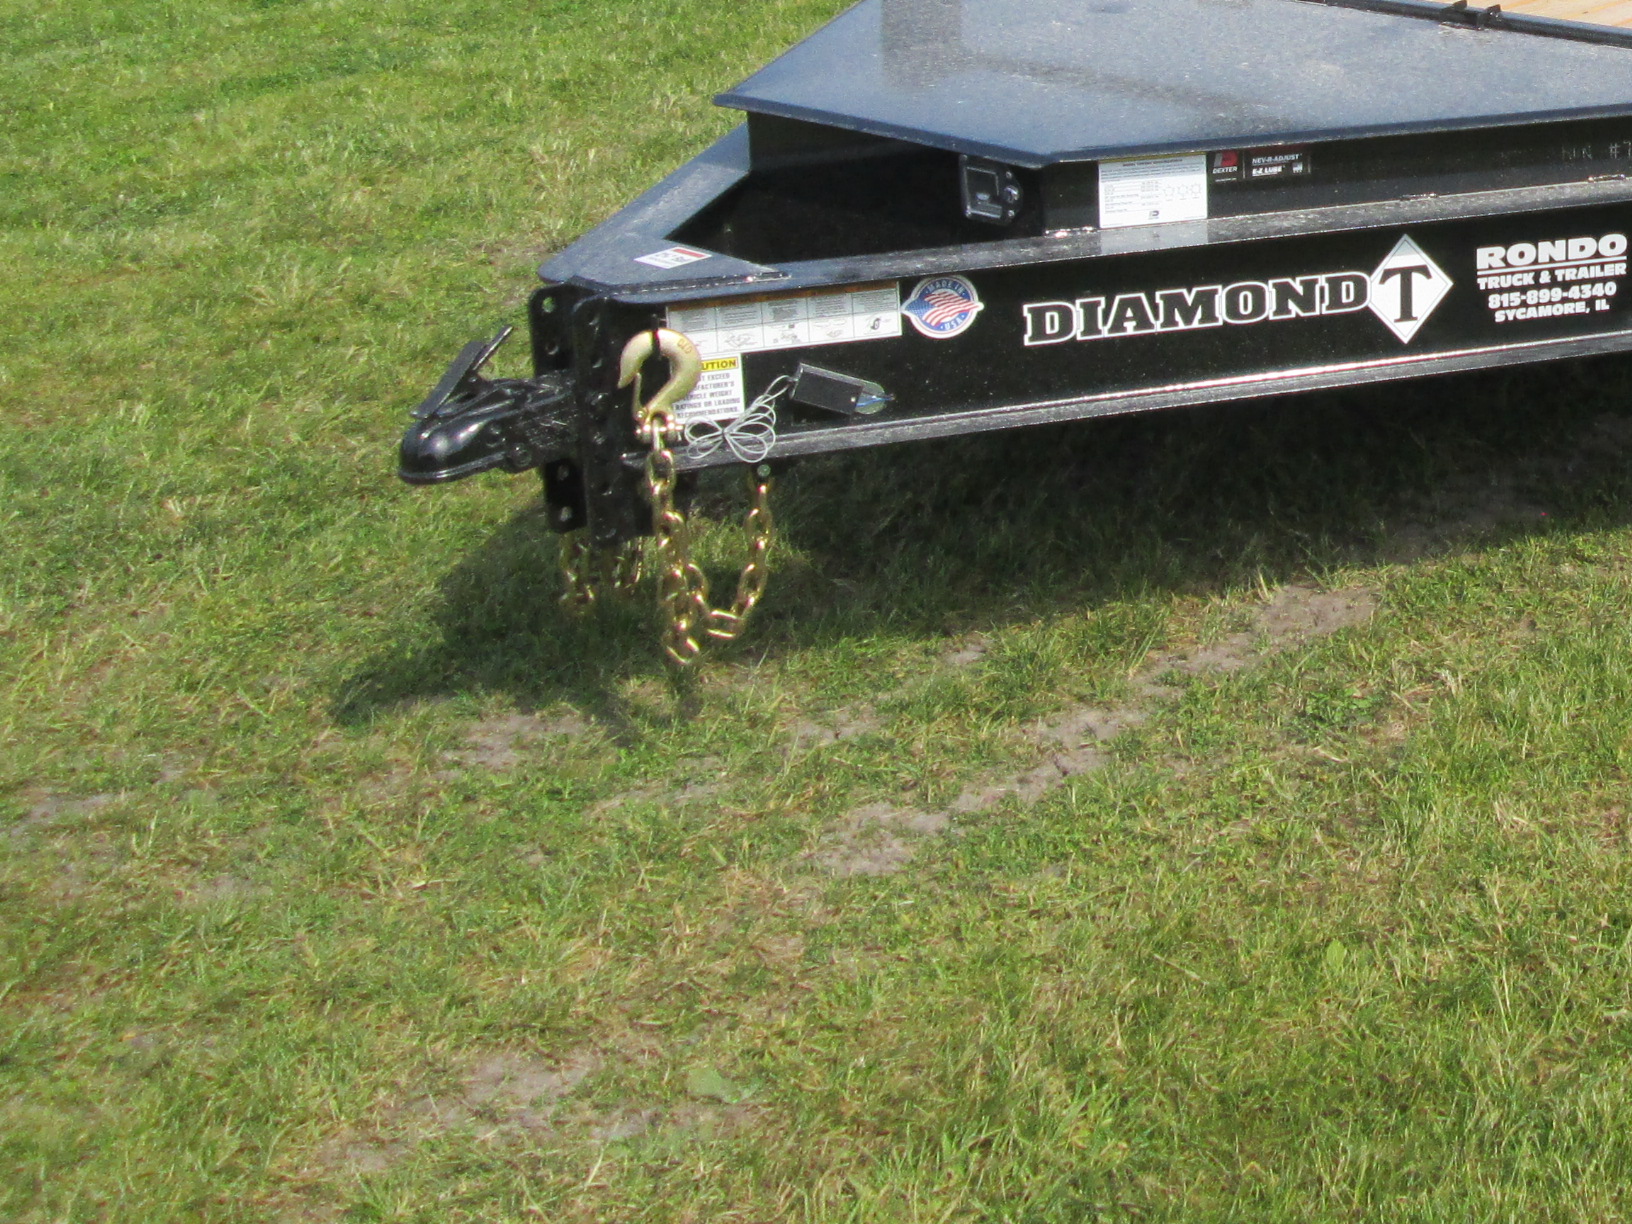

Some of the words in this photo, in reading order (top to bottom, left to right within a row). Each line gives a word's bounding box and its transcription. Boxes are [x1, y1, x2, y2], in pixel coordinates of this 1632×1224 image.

[1213, 166, 1238, 174] DEXTER
[1476, 233, 1628, 269] RONDO
[927, 280, 953, 292] MADE
[954, 281, 966, 294] IN
[1477, 272, 1535, 290] TRUCK
[1539, 270, 1551, 284] &
[1554, 262, 1627, 282] TRAILER
[1023, 272, 1371, 346] DIAMOND
[1378, 264, 1432, 324] T
[1488, 281, 1617, 309] 815-899-4340
[1494, 301, 1590, 323] SYCAMORE,
[1595, 298, 1610, 311] IL
[944, 316, 963, 331] USA
[701, 359, 736, 371] UTION
